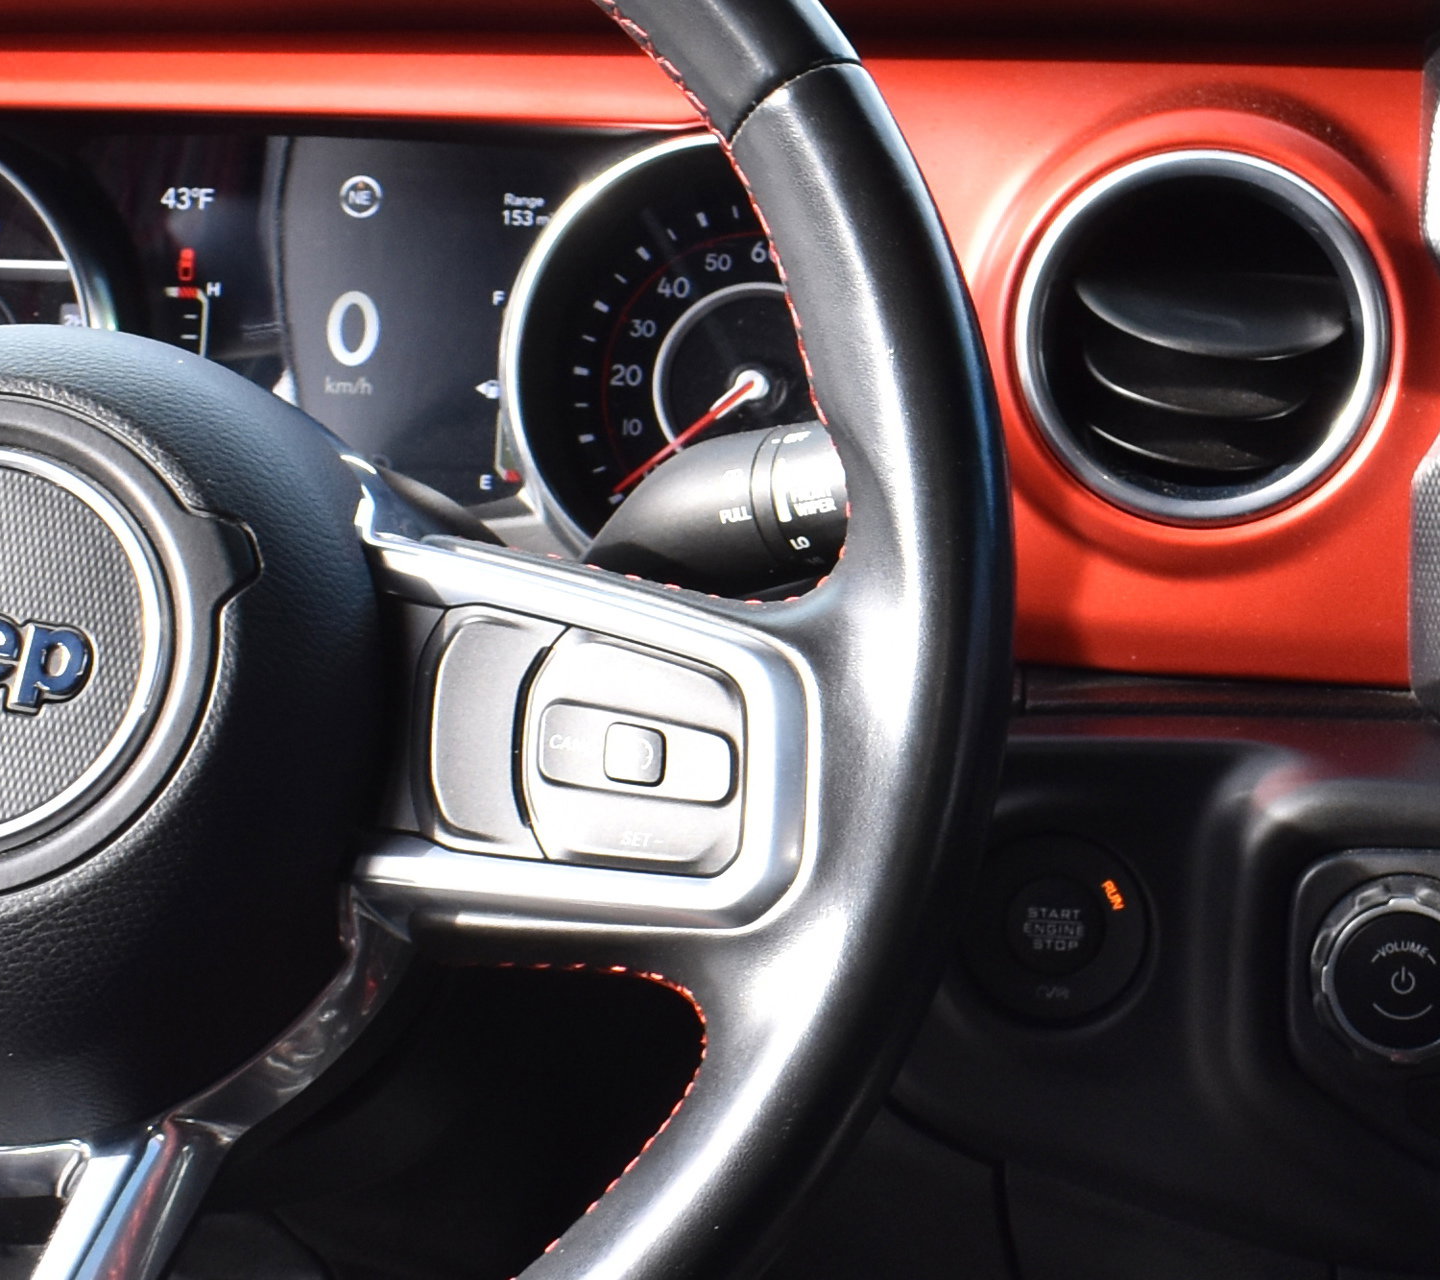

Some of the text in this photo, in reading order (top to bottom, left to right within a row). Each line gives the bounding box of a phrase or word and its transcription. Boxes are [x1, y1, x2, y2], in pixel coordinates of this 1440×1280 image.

[160, 187, 216, 211] 43°F
[348, 190, 373, 206] NE
[503, 192, 545, 209] Range
[502, 209, 534, 227] 153
[704, 253, 732, 272] 50
[206, 282, 221, 297] H
[656, 276, 691, 299] 40
[492, 290, 505, 306] F
[326, 290, 380, 367] 0
[629, 319, 656, 338] 30
[609, 364, 643, 386] 20
[324, 374, 373, 397] km/h
[622, 418, 643, 436] 10
[479, 474, 492, 491] E
[718, 506, 753, 525] PULL
[793, 497, 838, 517] WIPER
[789, 535, 811, 551] LO
[620, 830, 653, 848] SET
[1100, 878, 1127, 911] RUN
[1026, 906, 1082, 921] START
[1023, 921, 1086, 937] ENGINE
[1032, 938, 1080, 952] STOP
[1377, 941, 1429, 960] VOLUME
